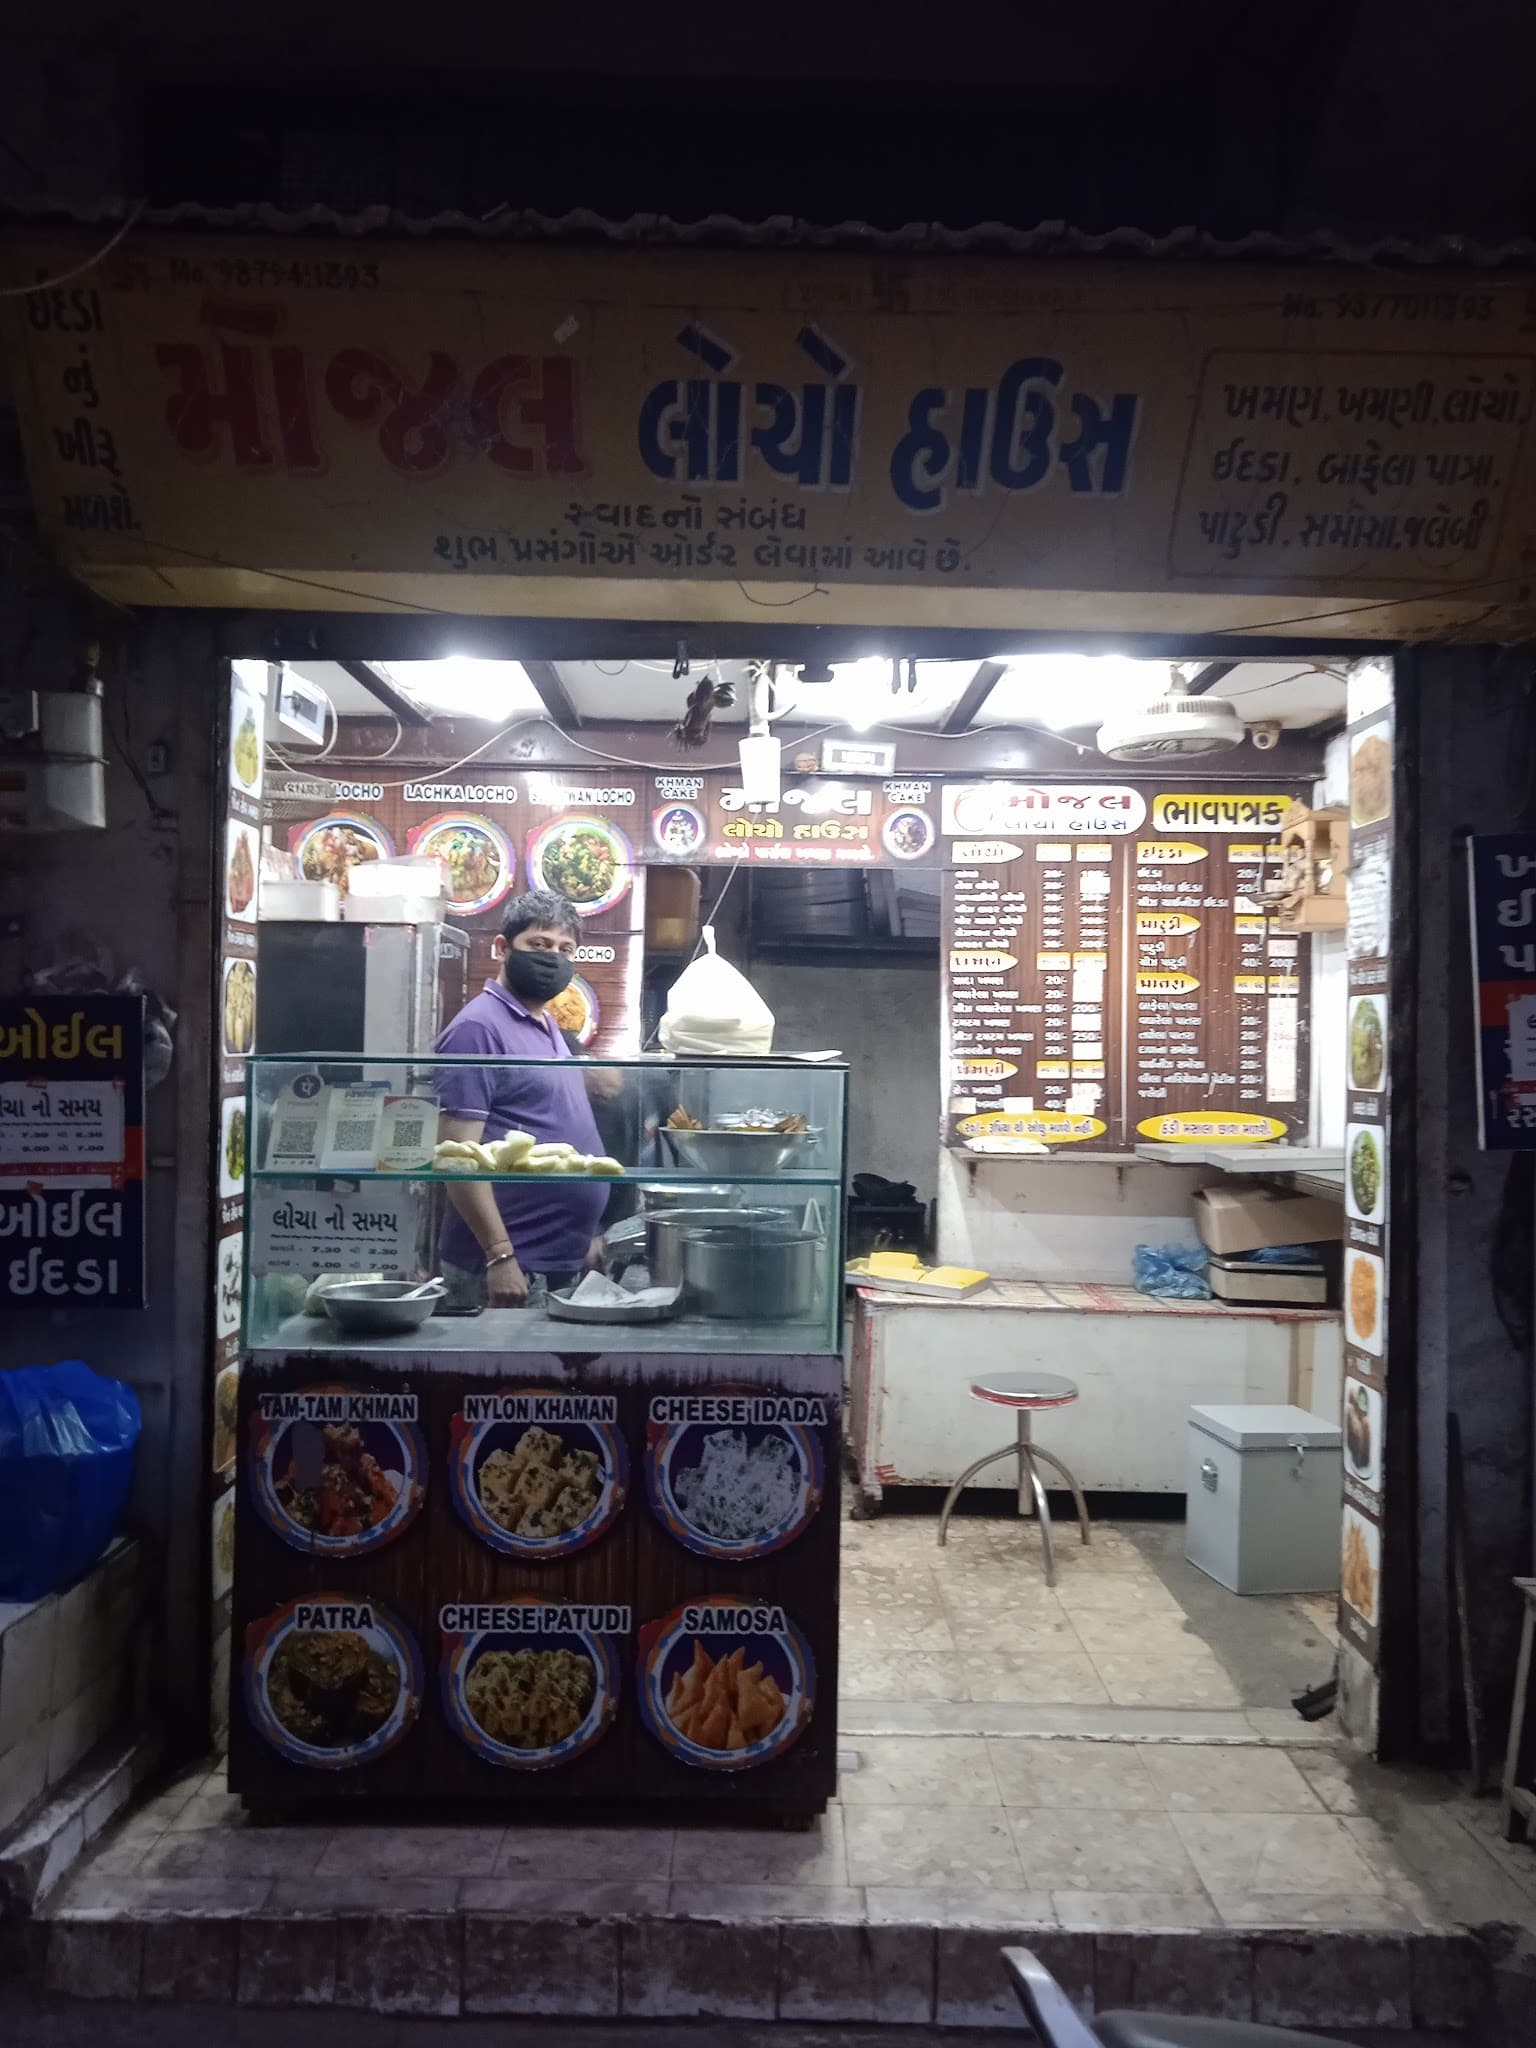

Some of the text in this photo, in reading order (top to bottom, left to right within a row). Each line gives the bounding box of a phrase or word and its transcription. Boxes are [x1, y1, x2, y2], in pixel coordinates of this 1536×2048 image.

[637, 321, 1140, 513] લોચો હાઉસ
[714, 497, 806, 531] સંબંધ
[433, 534, 497, 569] શુભ
[335, 784, 382, 799] LOCHO
[406, 785, 515, 802] LACHKA LOCHO
[657, 778, 703, 788] KHMAN
[663, 789, 696, 799] CAKE
[884, 782, 931, 792] KHMAN
[596, 790, 634, 804] LOCHO
[890, 793, 923, 803] CAKE
[1162, 801, 1286, 826] ભાવપત્રક
[575, 948, 613, 961] OCHO
[31, 1091, 51, 1118] નો
[56, 1098, 104, 1118] સમય
[272, 1201, 318, 1232] લોચા
[324, 1203, 346, 1232] નો
[351, 1210, 399, 1233] સમય
[8, 1247, 119, 1297] ઈદડા
[262, 1397, 417, 1421] TAM-TAM KHMAN
[464, 1397, 616, 1422] NYLON KHAMAN
[650, 1398, 827, 1425] CHEESE IDADA
[296, 1605, 373, 1630] PATRA
[440, 1606, 630, 1633] CHEESE PATUDI
[683, 1607, 786, 1633] SAMOSA
